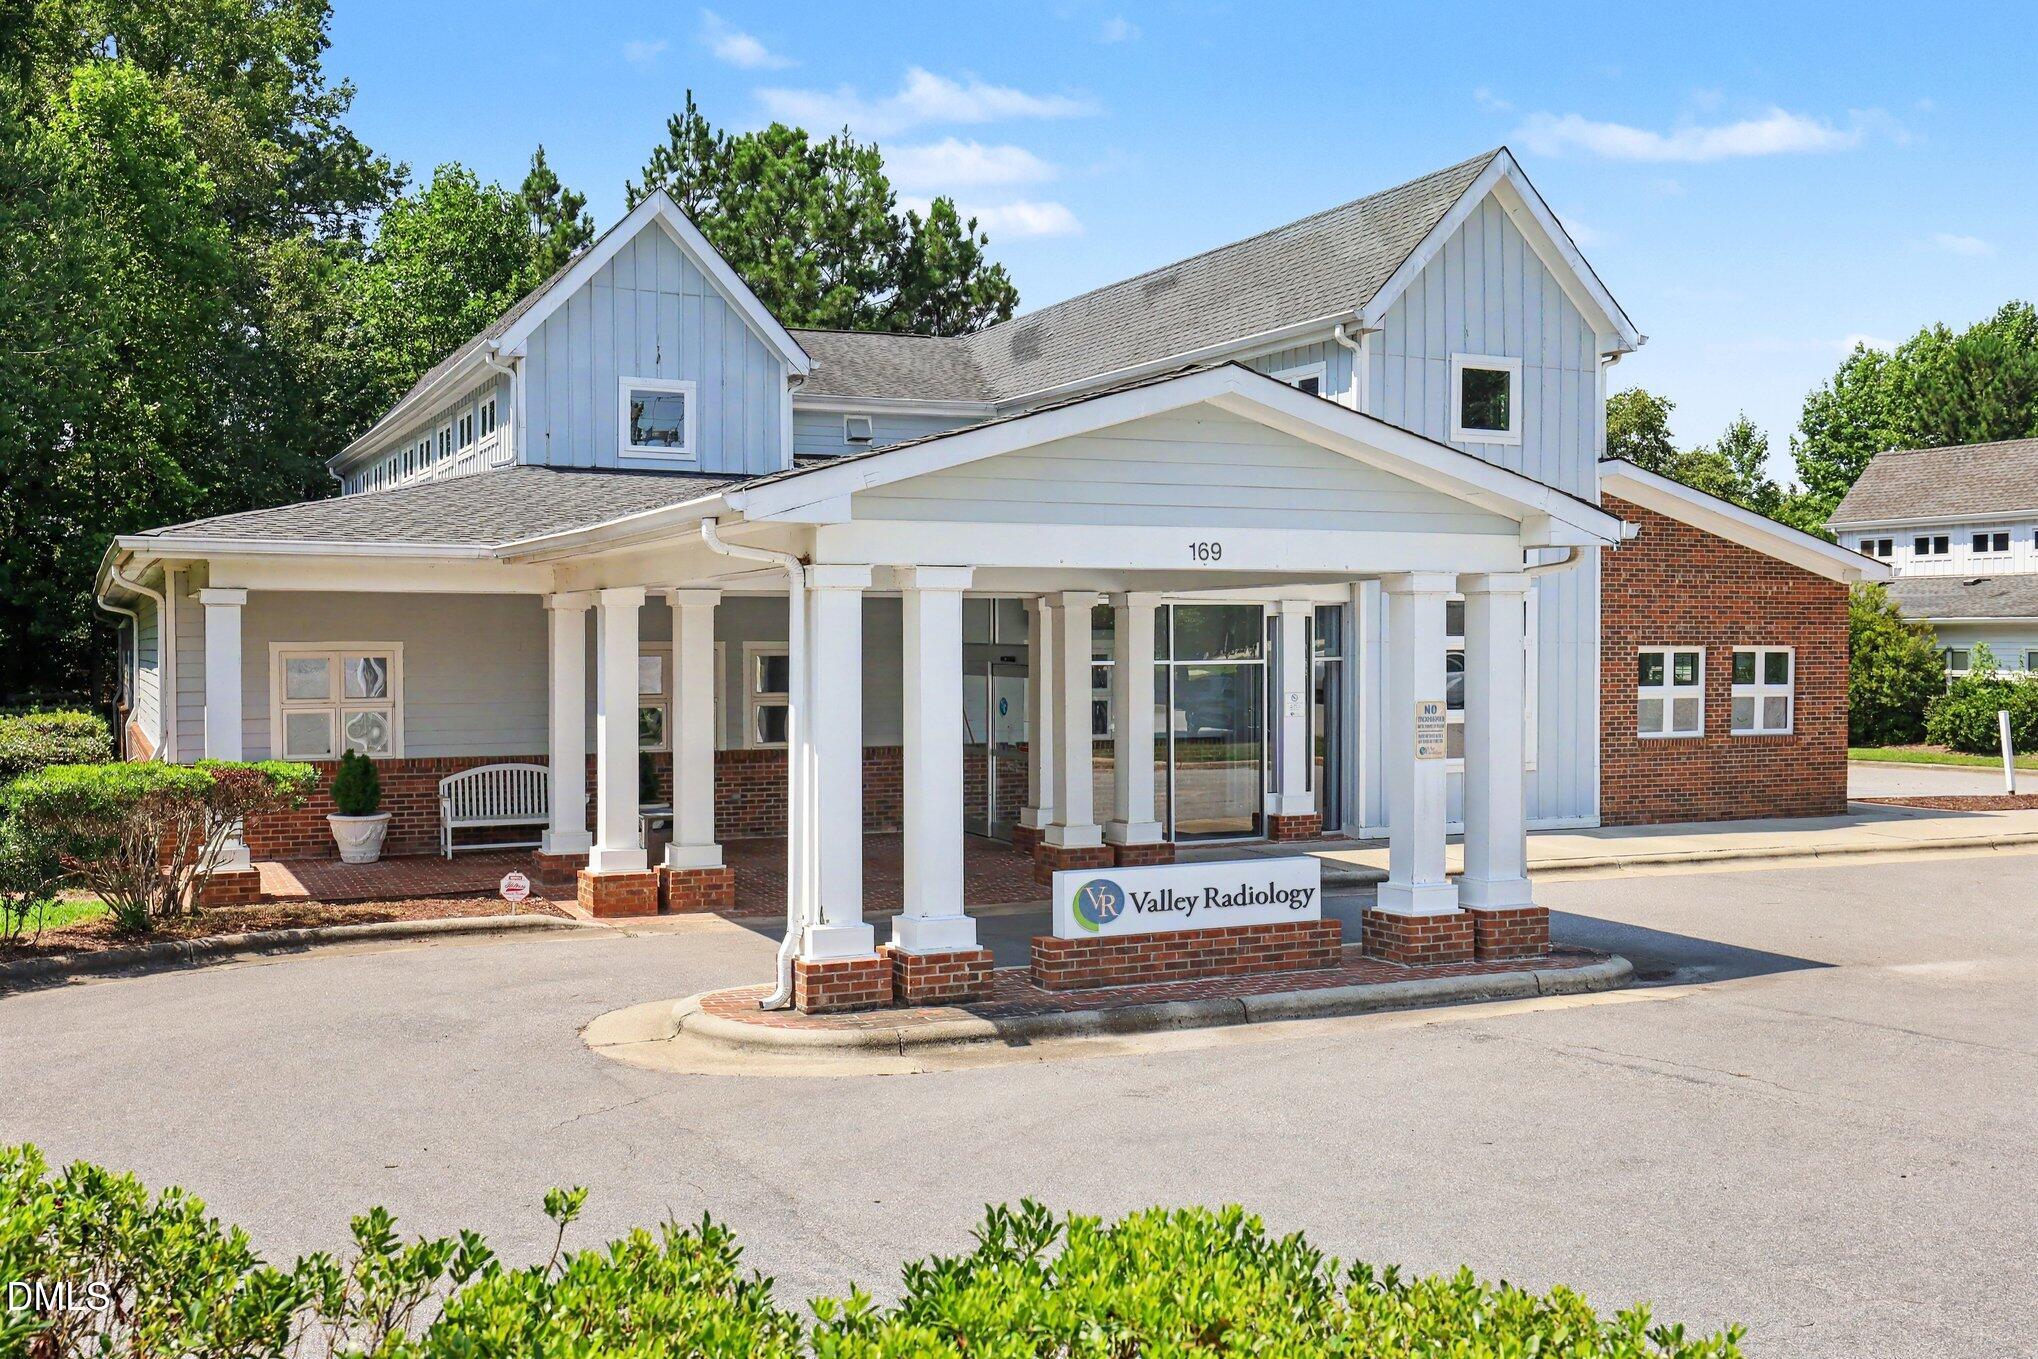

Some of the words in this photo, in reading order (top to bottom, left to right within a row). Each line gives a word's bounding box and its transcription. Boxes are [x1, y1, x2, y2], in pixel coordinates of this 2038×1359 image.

[1189, 542, 1222, 561] 169
[1424, 704, 1438, 715] NO
[1084, 886, 1119, 917] VR
[1128, 889, 1199, 917] Valley
[1203, 882, 1316, 909] Radiology
